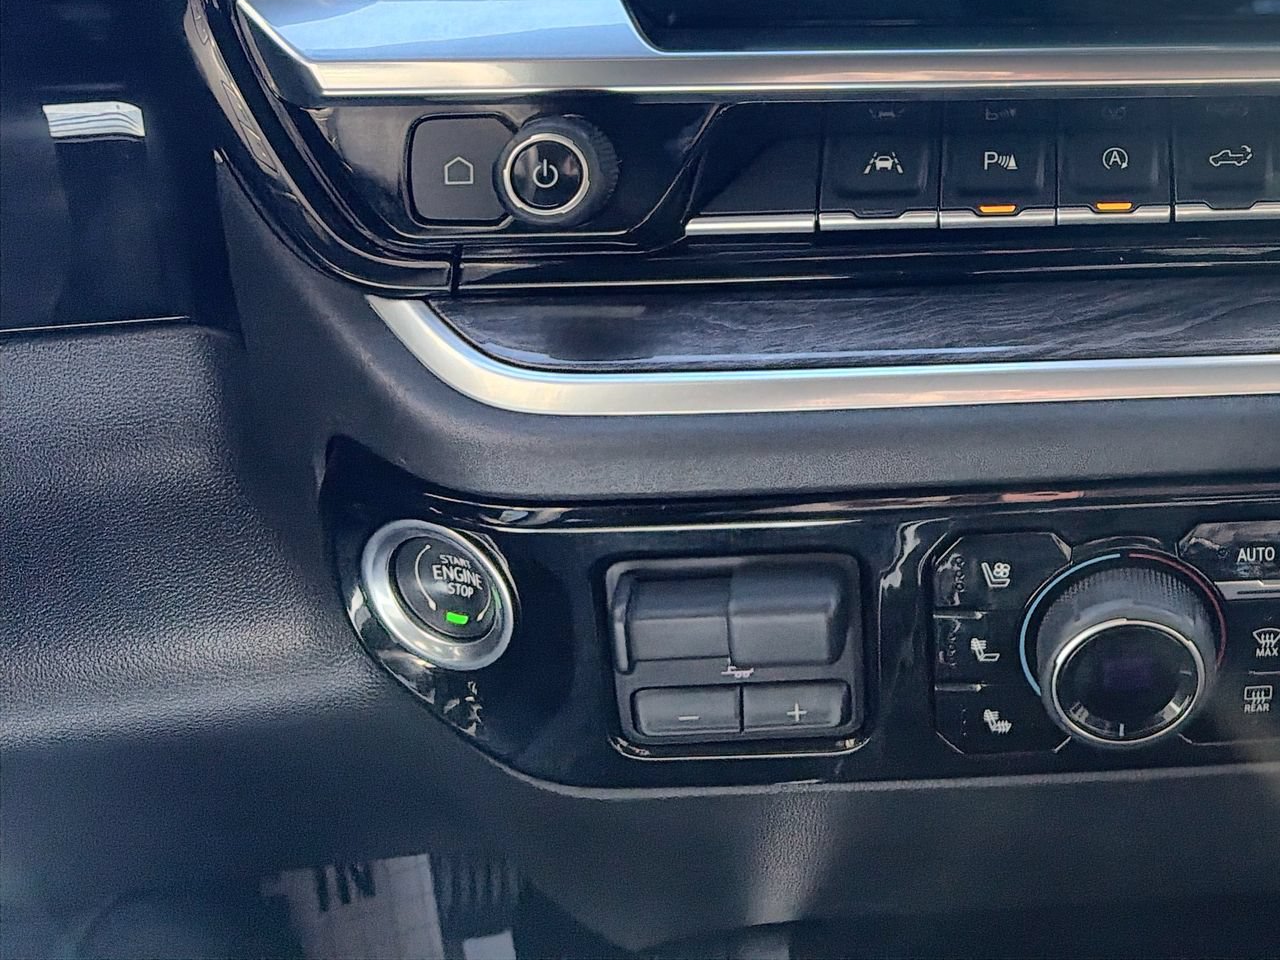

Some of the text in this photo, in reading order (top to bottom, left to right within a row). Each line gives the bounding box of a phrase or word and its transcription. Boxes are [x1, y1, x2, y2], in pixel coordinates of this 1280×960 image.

[440, 554, 471, 568] START
[1238, 547, 1275, 563] AUTO
[433, 564, 484, 590] ENGINE
[447, 582, 474, 598] STOP
[1255, 647, 1278, 657] MAX
[1244, 703, 1269, 713] REAR
